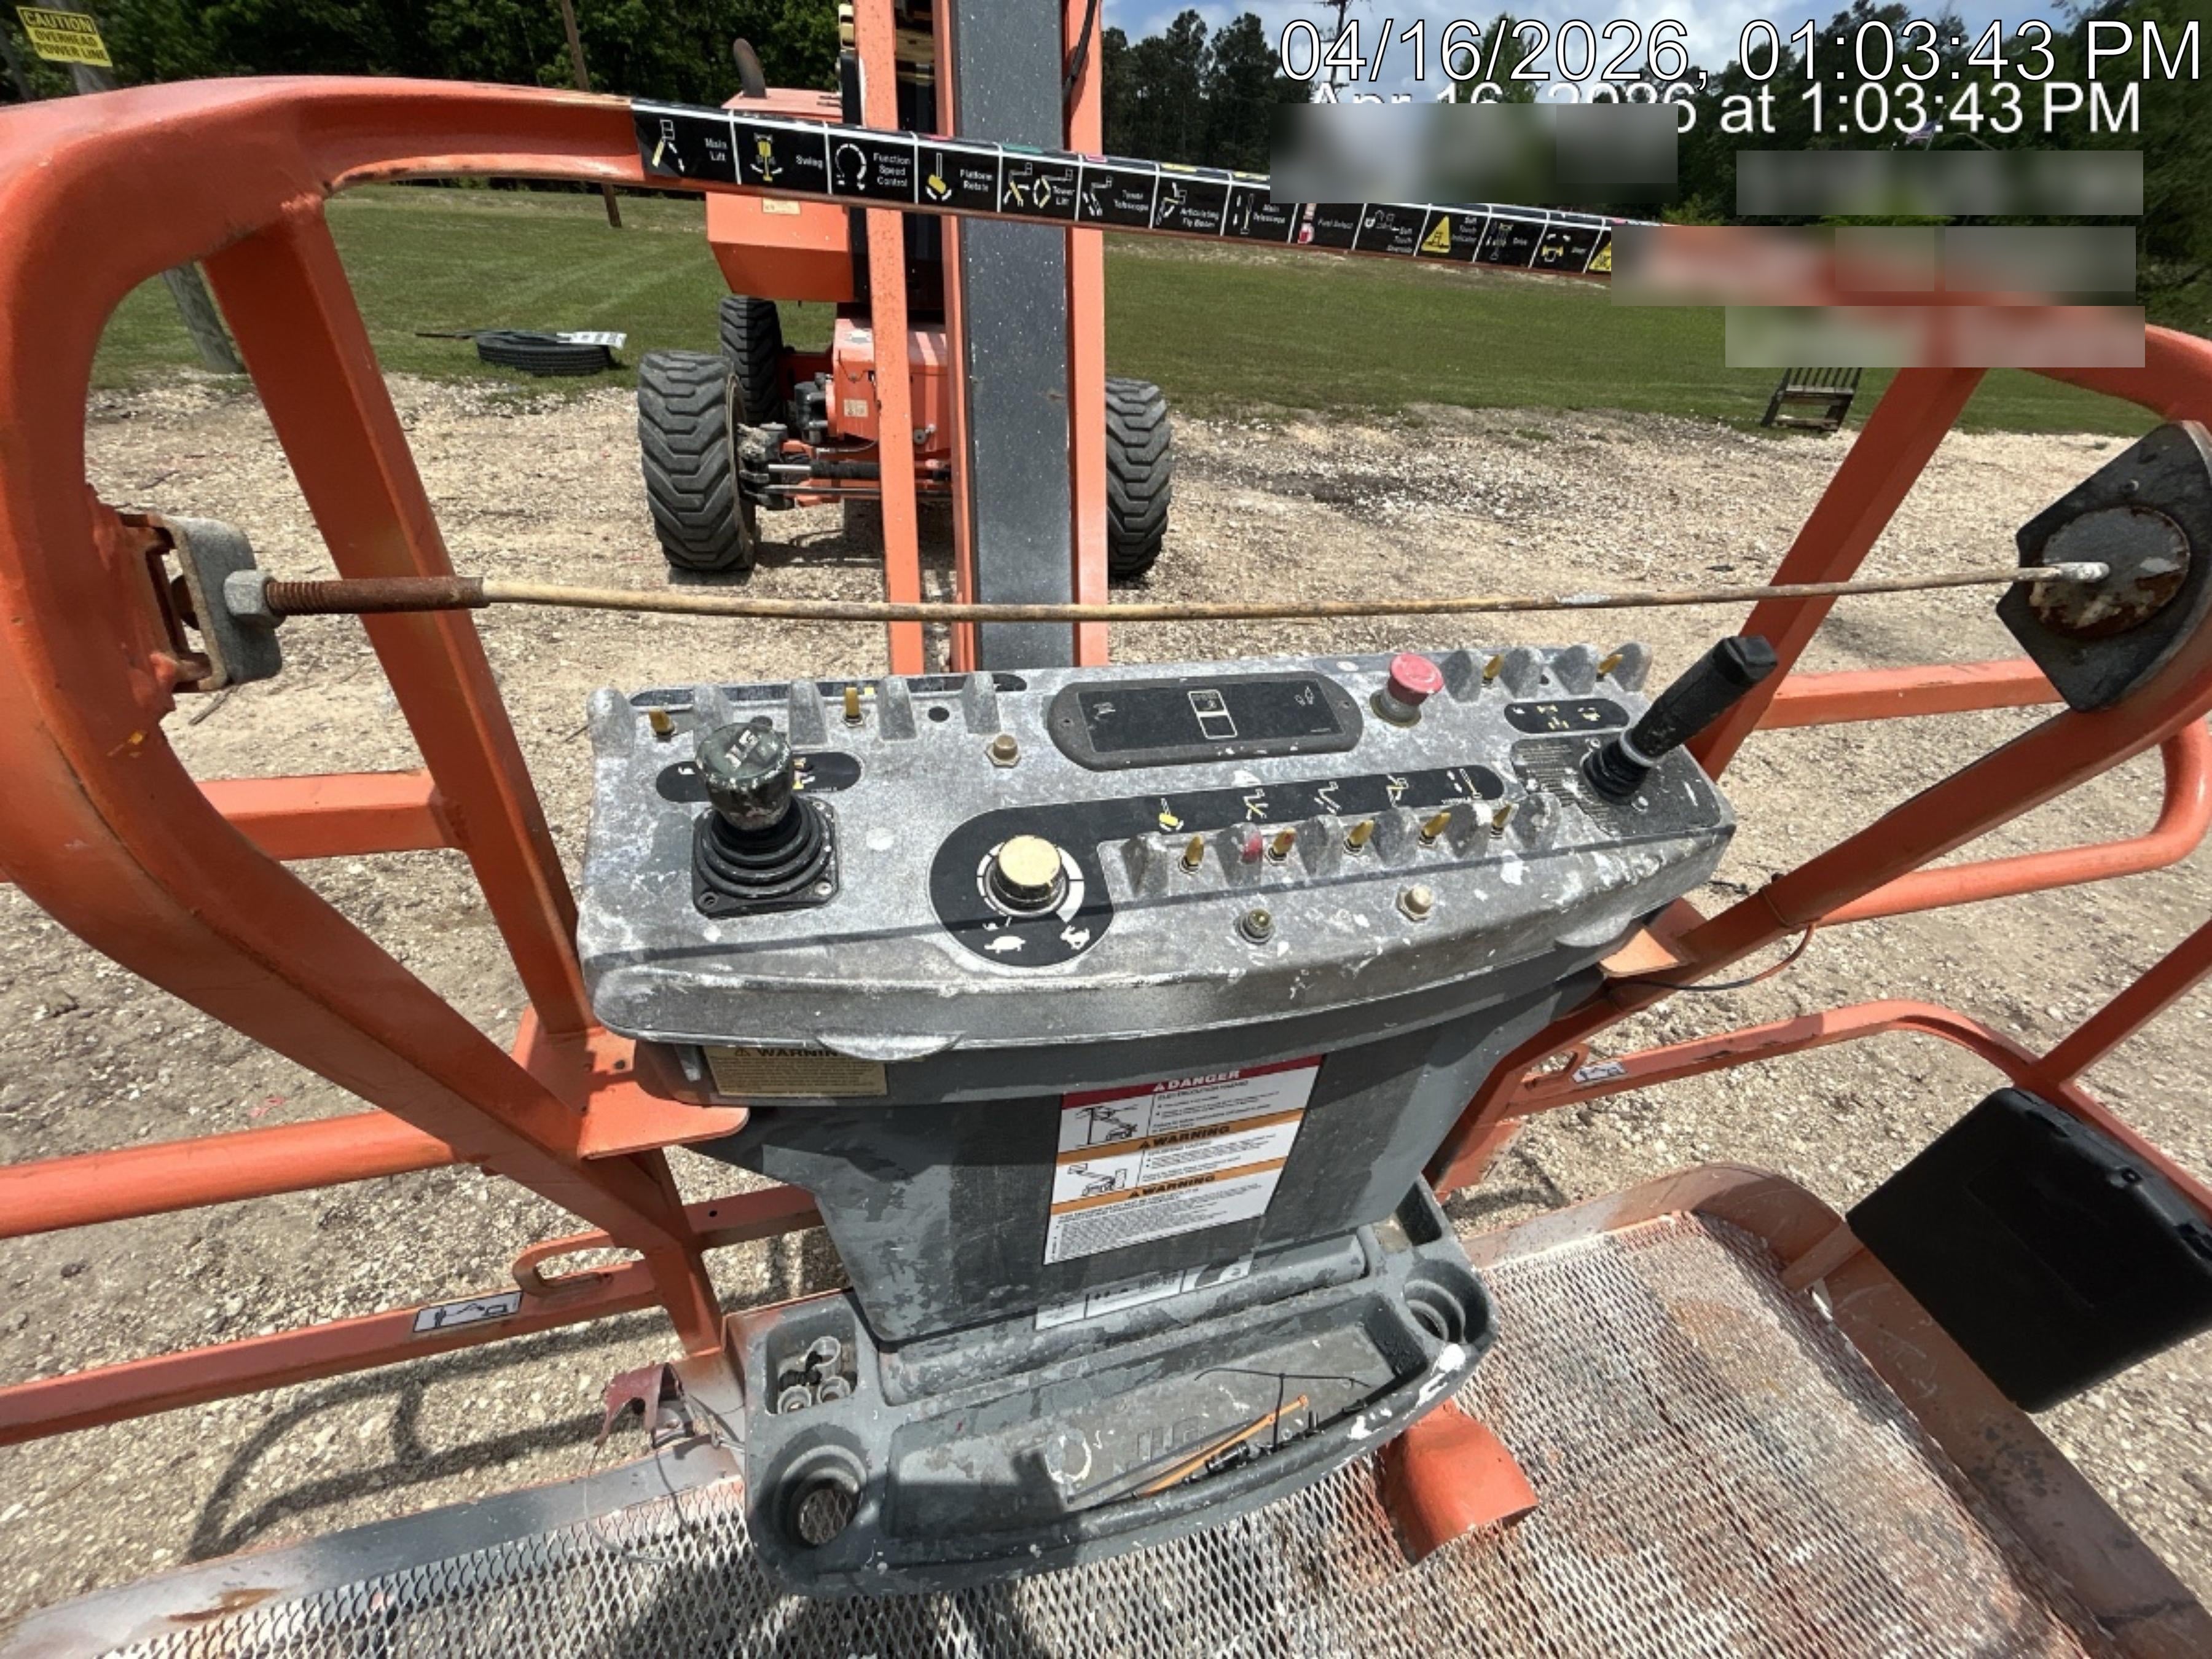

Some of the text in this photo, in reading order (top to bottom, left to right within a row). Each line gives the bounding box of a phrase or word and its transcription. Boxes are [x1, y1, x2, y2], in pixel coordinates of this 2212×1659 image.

[25, 11, 93, 32] CAUTION
[704, 138, 728, 149] Main
[710, 151, 726, 162] Lift
[796, 155, 823, 170] Swing
[873, 152, 911, 165] Function
[879, 164, 906, 176] Speed
[960, 169, 992, 181] Platform
[877, 176, 908, 187] Control
[963, 181, 989, 192] Rotate
[1053, 185, 1075, 195] Tower
[1113, 198, 1149, 213] Telescope
[756, 1048, 839, 1057] WARNIN
[1167, 1070, 1241, 1090] DANGER
[1153, 1126, 1230, 1146] WARNING
[1142, 1174, 1216, 1195] WARNING
